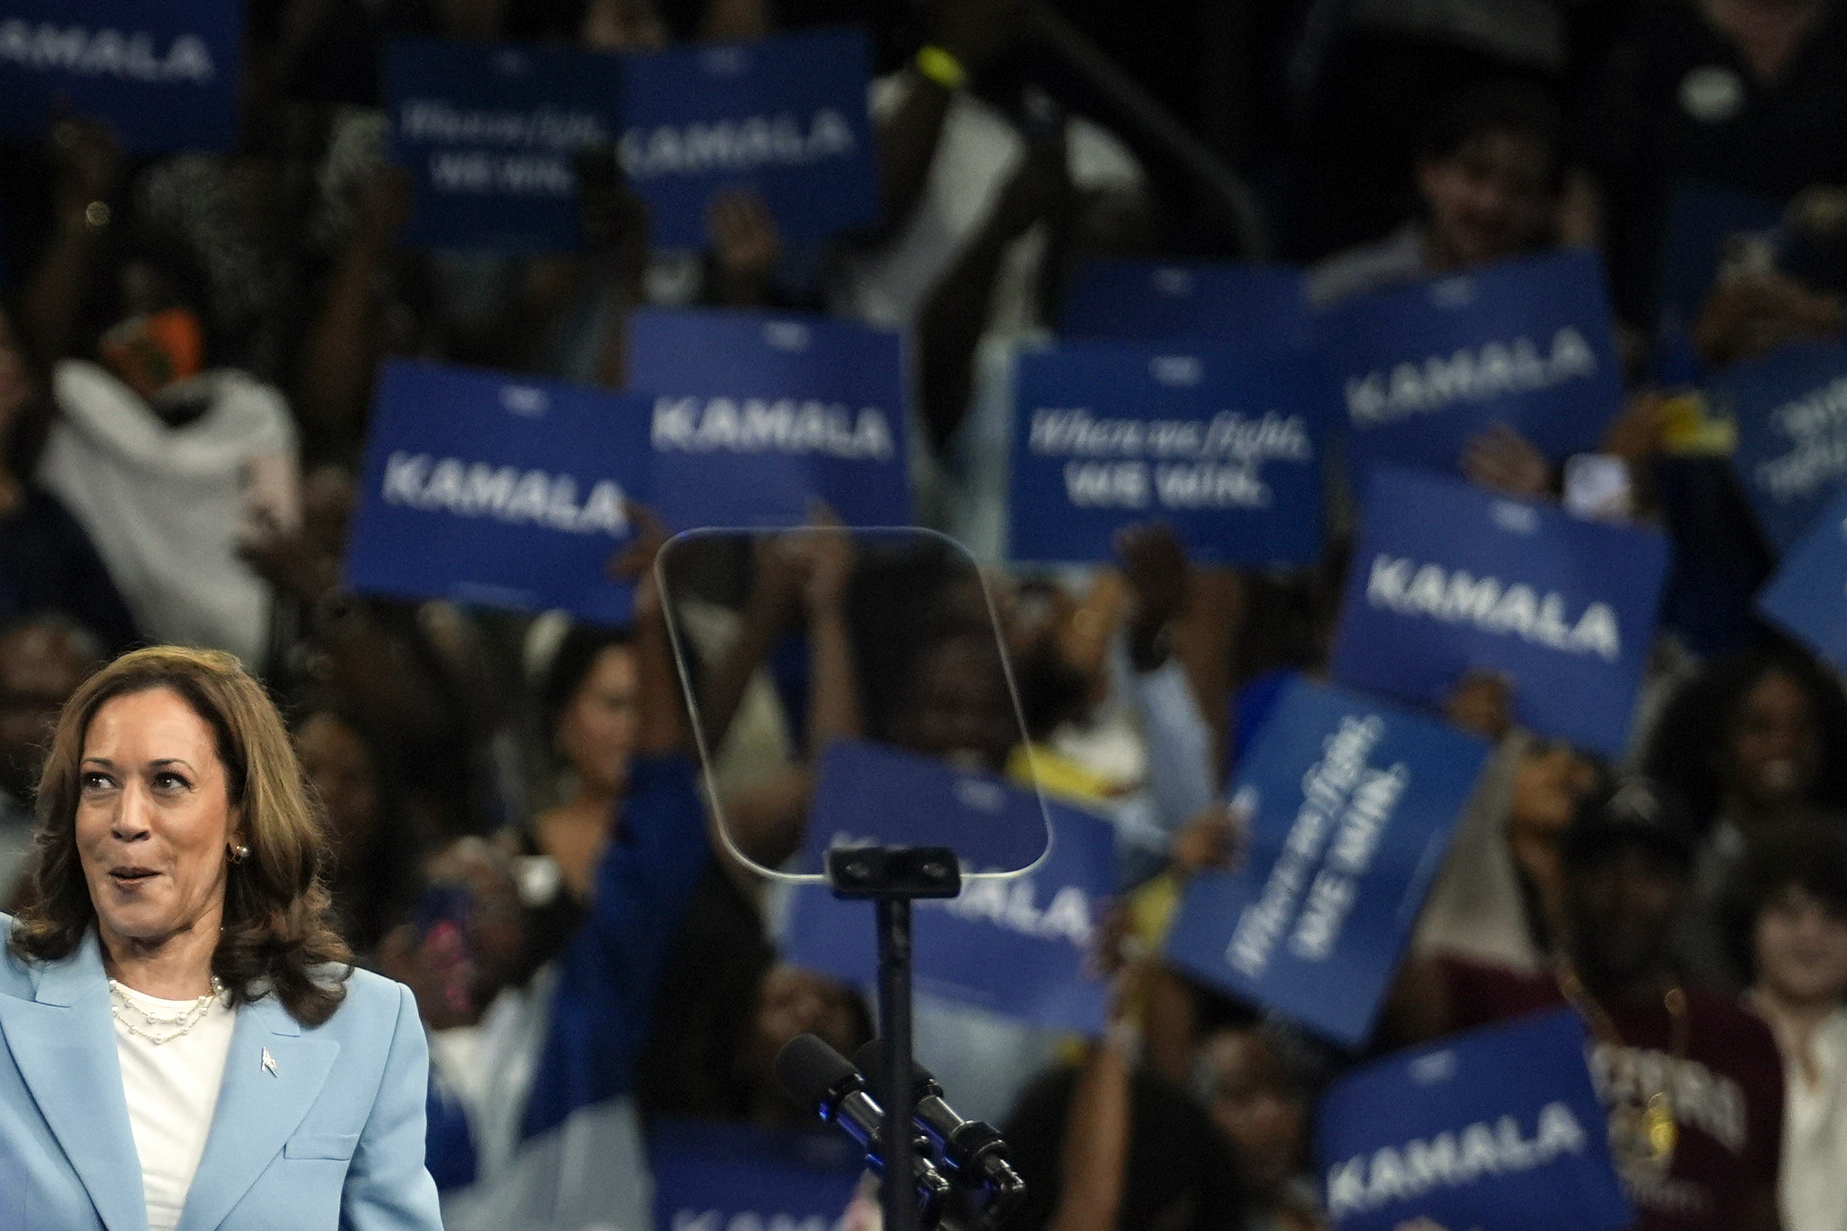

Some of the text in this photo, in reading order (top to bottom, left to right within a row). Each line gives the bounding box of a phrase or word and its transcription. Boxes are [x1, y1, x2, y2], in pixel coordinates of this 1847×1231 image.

[1345, 325, 1596, 430] KAMALA
[651, 395, 893, 463] KAMALA
[1028, 407, 1147, 456] When
[381, 450, 629, 538] KAMALA
[1063, 460, 1150, 509] WE
[1366, 553, 1621, 665] KAMALA
[1327, 1101, 1587, 1215] KAMALA
